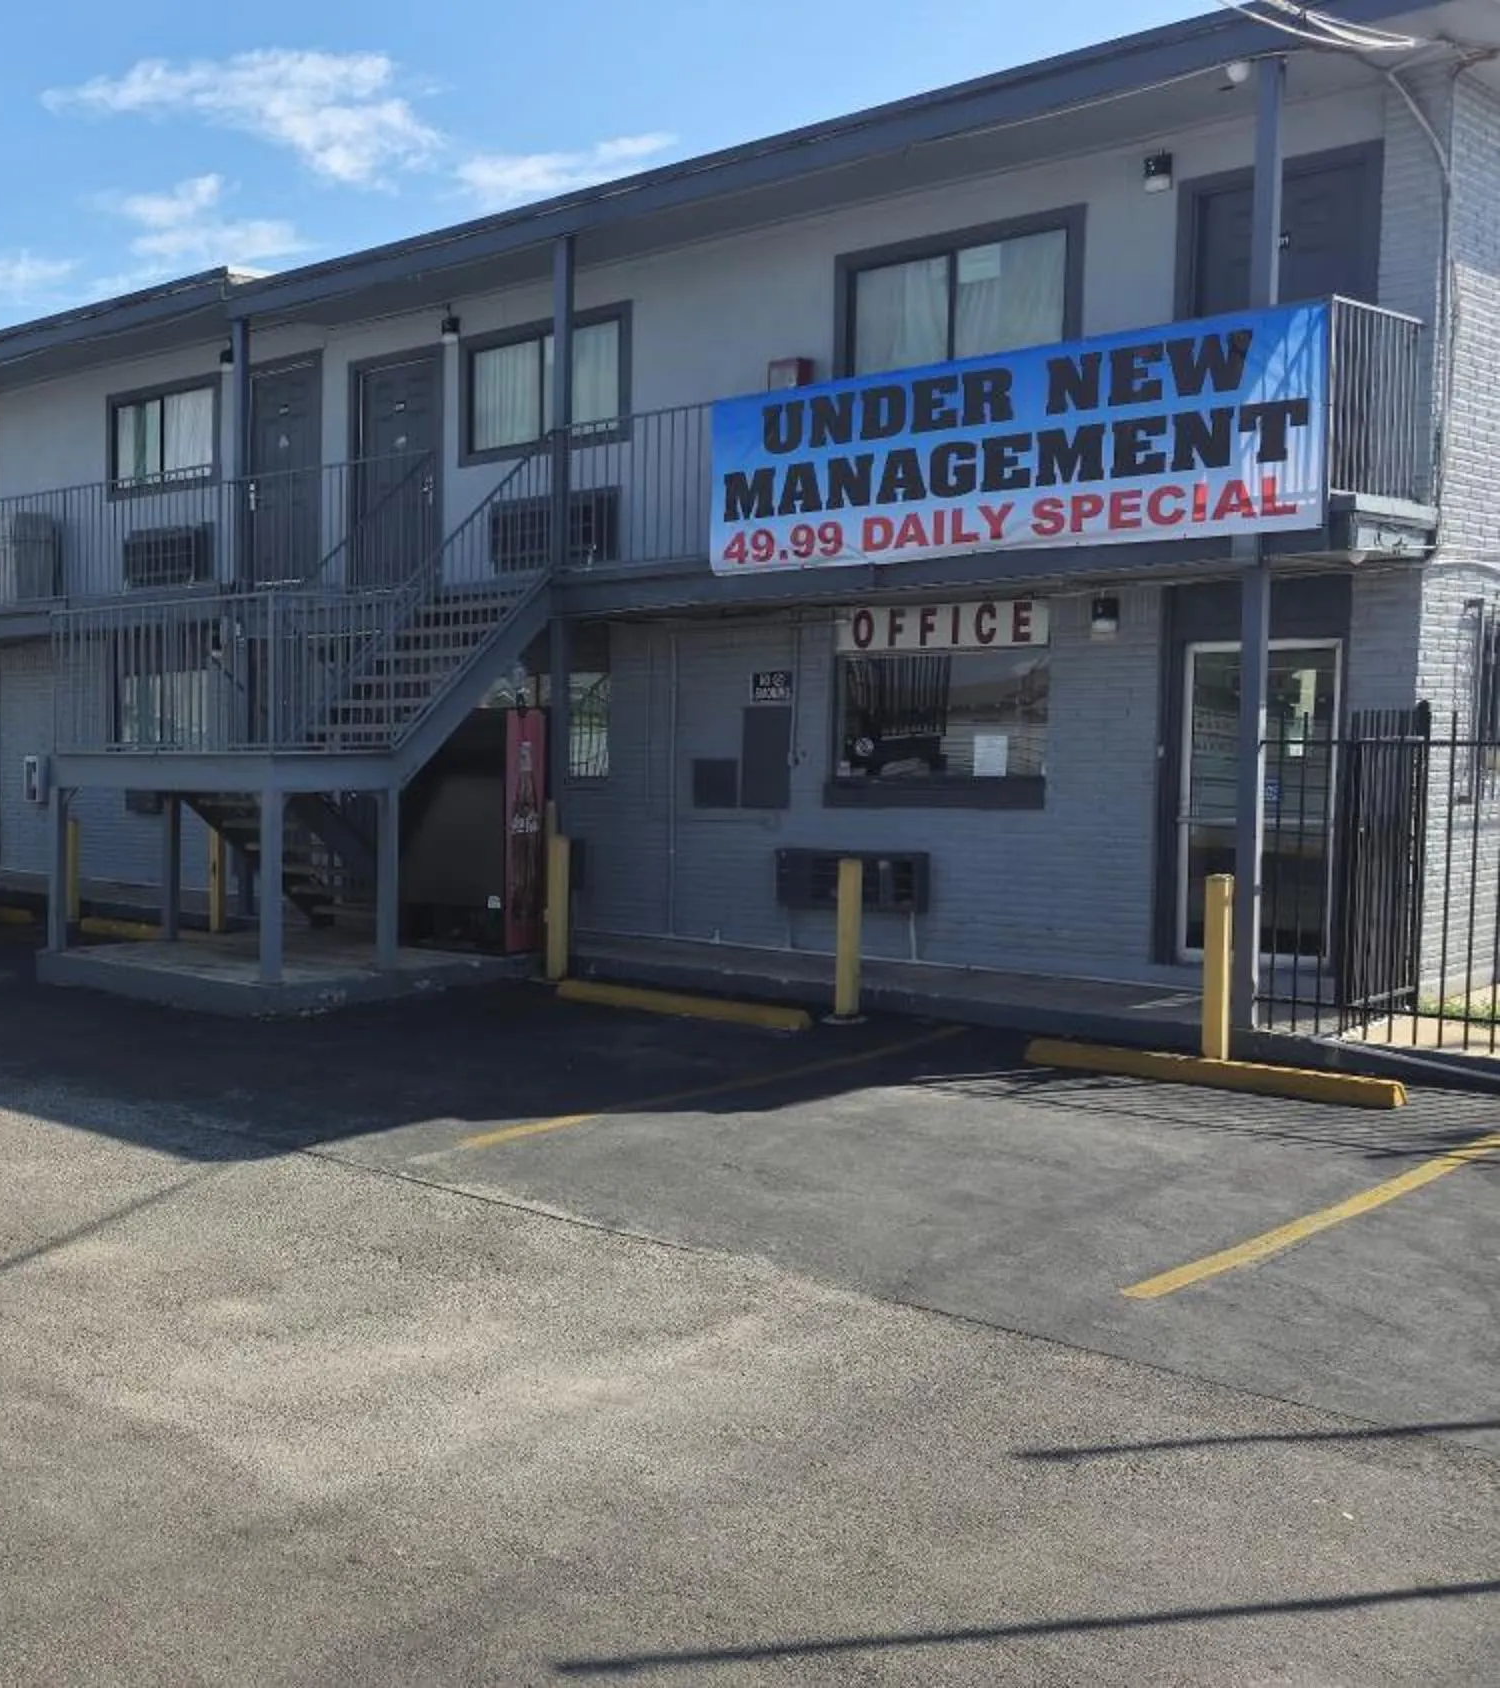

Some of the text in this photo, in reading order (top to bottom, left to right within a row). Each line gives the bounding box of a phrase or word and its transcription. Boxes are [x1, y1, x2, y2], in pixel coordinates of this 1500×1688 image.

[763, 329, 1253, 454] UNDER NEW
[723, 398, 1309, 522] MANAGEMENT
[723, 476, 1297, 564] 49.99 DAILY SPECIAL
[853, 602, 1033, 648] OFFICE
